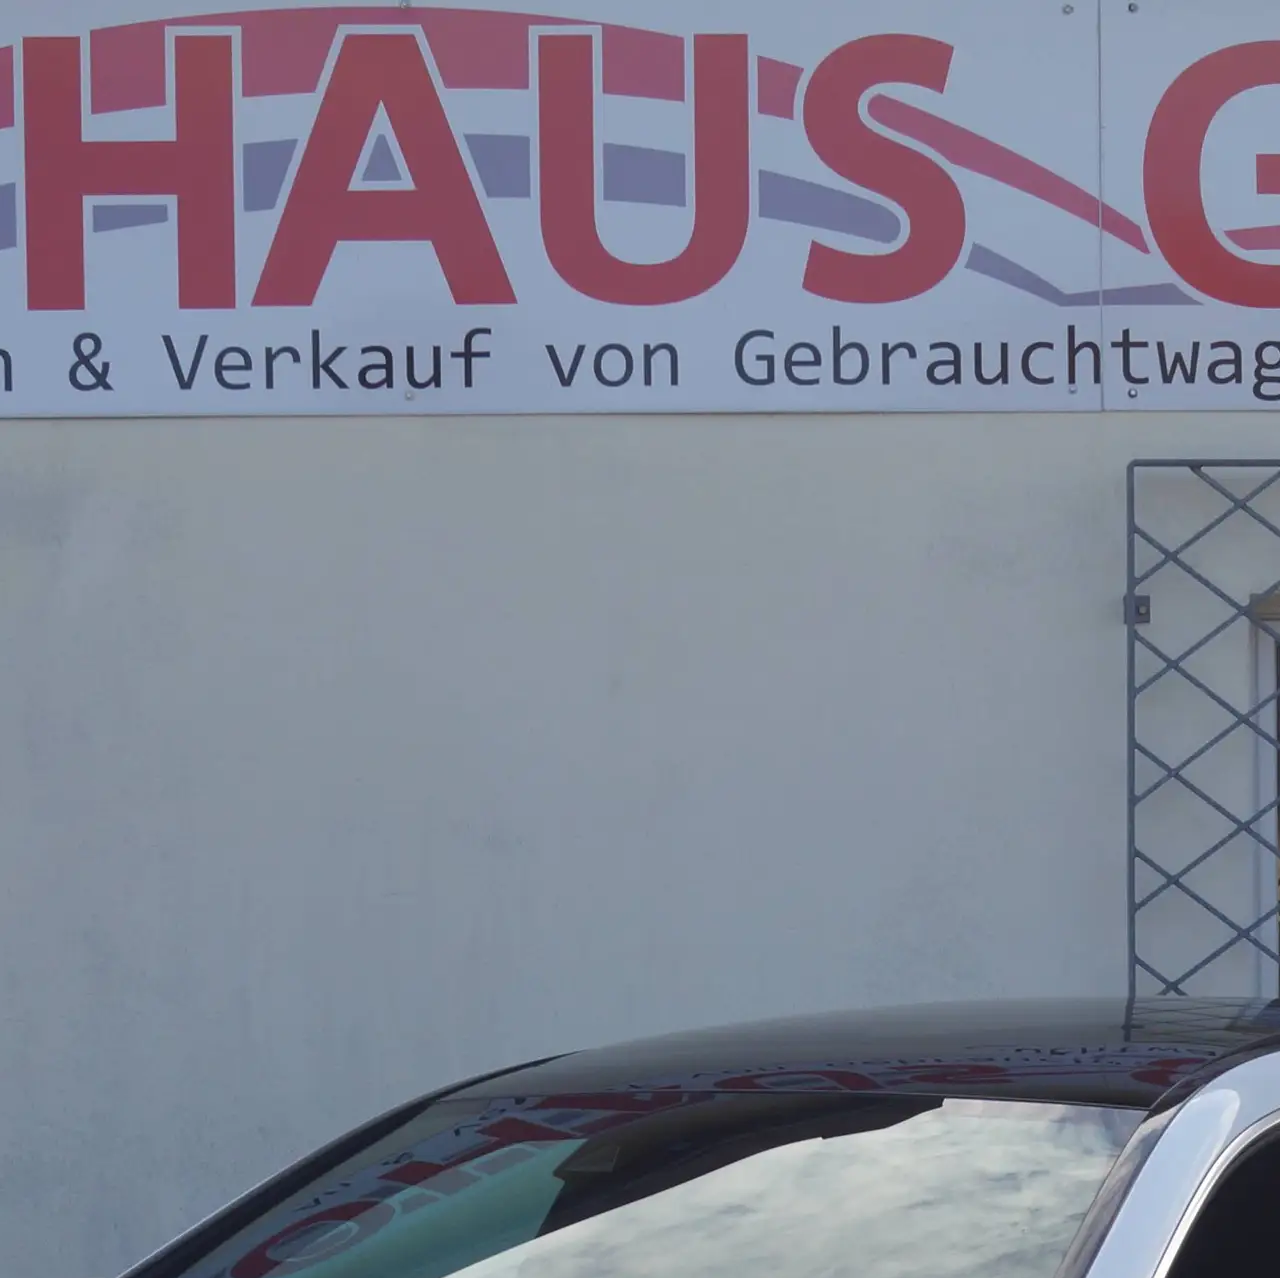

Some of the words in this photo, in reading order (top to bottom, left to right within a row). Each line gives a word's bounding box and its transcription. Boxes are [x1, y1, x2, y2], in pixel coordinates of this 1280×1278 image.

[68, 331, 114, 392] &
[162, 327, 492, 392] Verkauf
[545, 339, 681, 389] von
